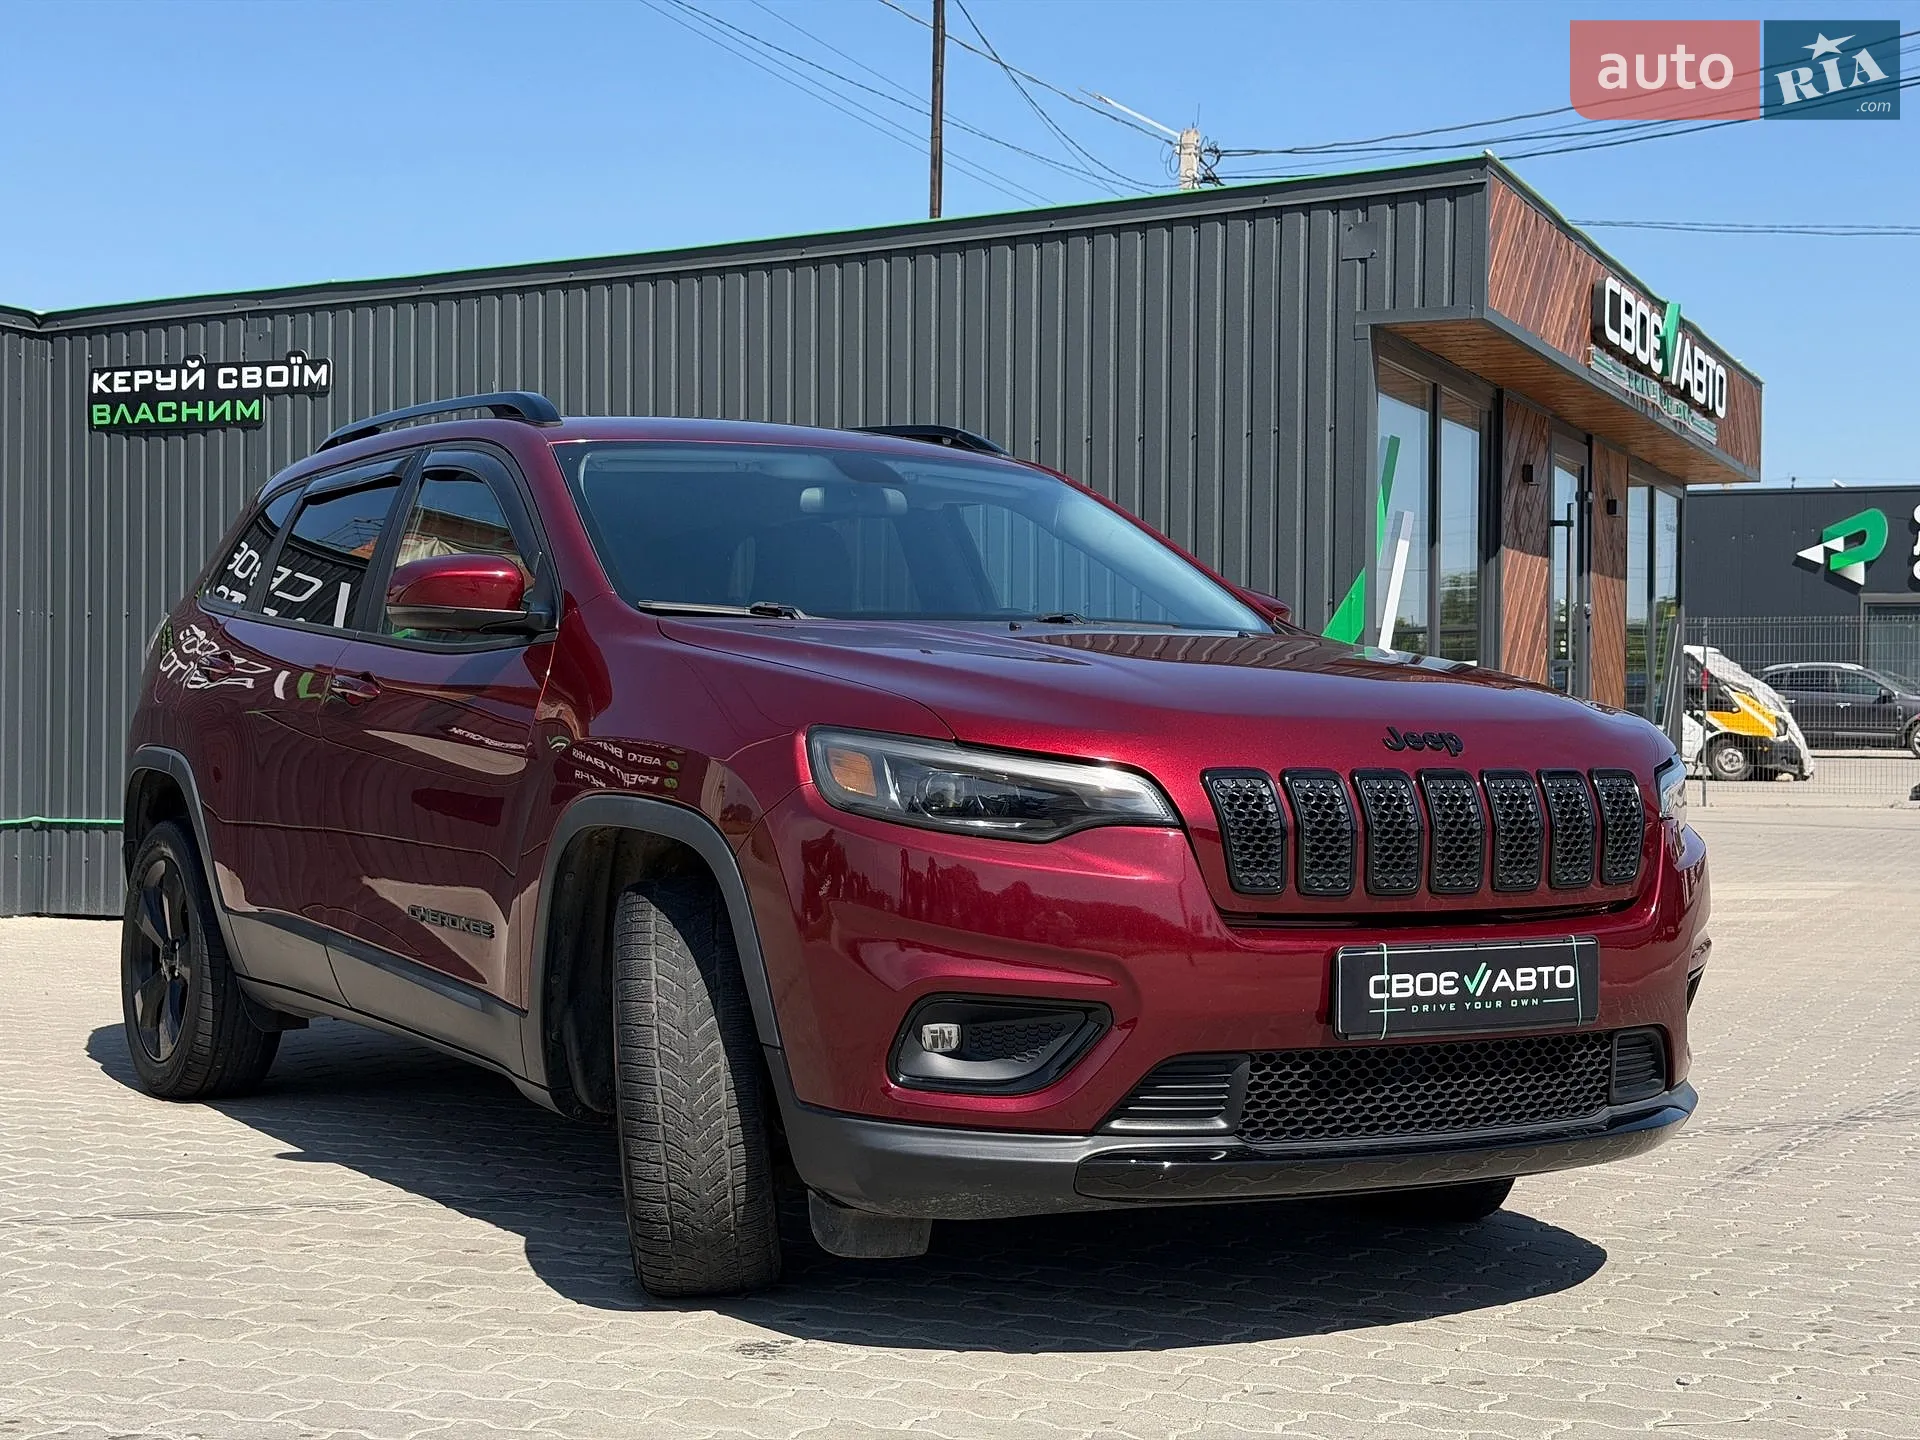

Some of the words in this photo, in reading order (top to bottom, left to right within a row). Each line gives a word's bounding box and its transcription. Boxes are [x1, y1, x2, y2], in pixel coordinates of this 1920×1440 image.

[92, 359, 205, 394] КЕРУЙ
[217, 356, 328, 390] СВОЇМ
[1679, 338, 1727, 419] АВТО
[92, 399, 260, 425] ВЛАСНИМ
[1382, 726, 1464, 758] Jeep
[407, 904, 495, 939] CHEROKEE
[1491, 965, 1575, 993] АВТО
[1411, 1002, 1456, 1013] DRIVE
[1464, 1000, 1502, 1010] YOUR
[1510, 998, 1540, 1008] OWN
